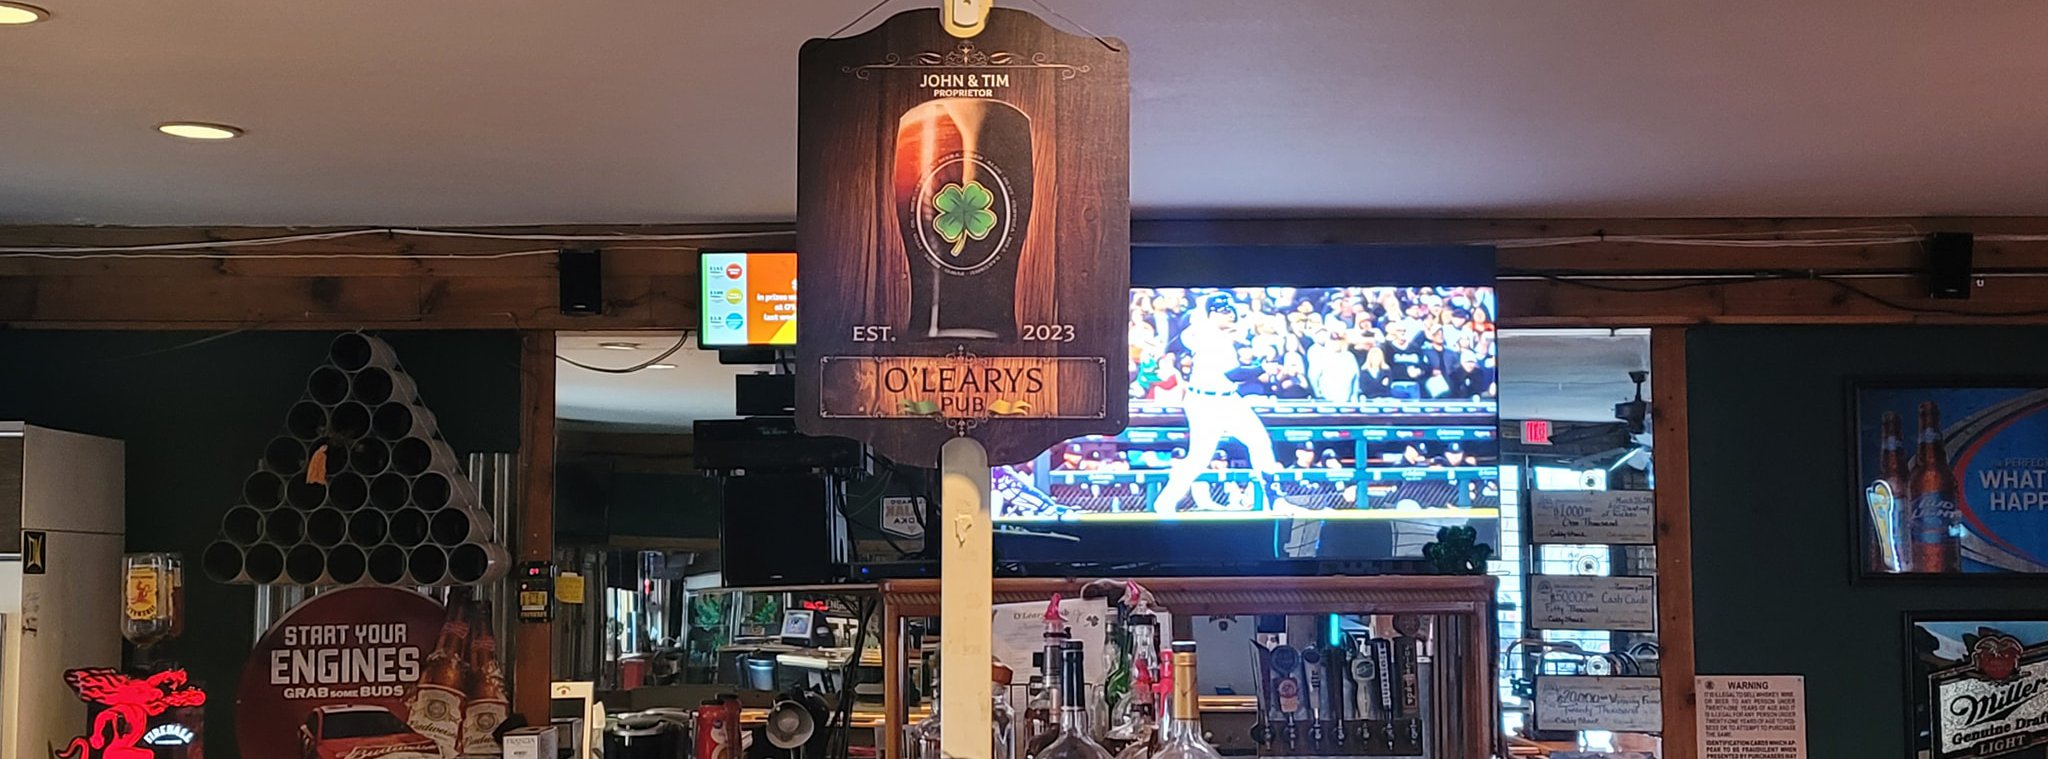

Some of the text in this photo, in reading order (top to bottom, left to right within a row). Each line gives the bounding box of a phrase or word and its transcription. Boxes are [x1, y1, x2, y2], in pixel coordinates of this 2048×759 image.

[920, 74, 1010, 87] JOHN & TIM
[933, 89, 993, 97] PROPRIETOR
[852, 326, 897, 342] EST.
[1022, 325, 1076, 342] 2023
[884, 367, 1043, 393] O'LEARYS
[941, 396, 985, 412] PUB
[1980, 469, 2046, 489] WHAT
[1990, 491, 2048, 511] HAPP
[284, 623, 407, 647] START YOUR
[270, 646, 420, 685] ENGINES
[283, 685, 404, 699] GRAB SOME BUDS
[1727, 681, 1768, 690] WARNING
[1952, 722, 2011, 745] Genuine
[1980, 735, 2026, 755] LIGHT
